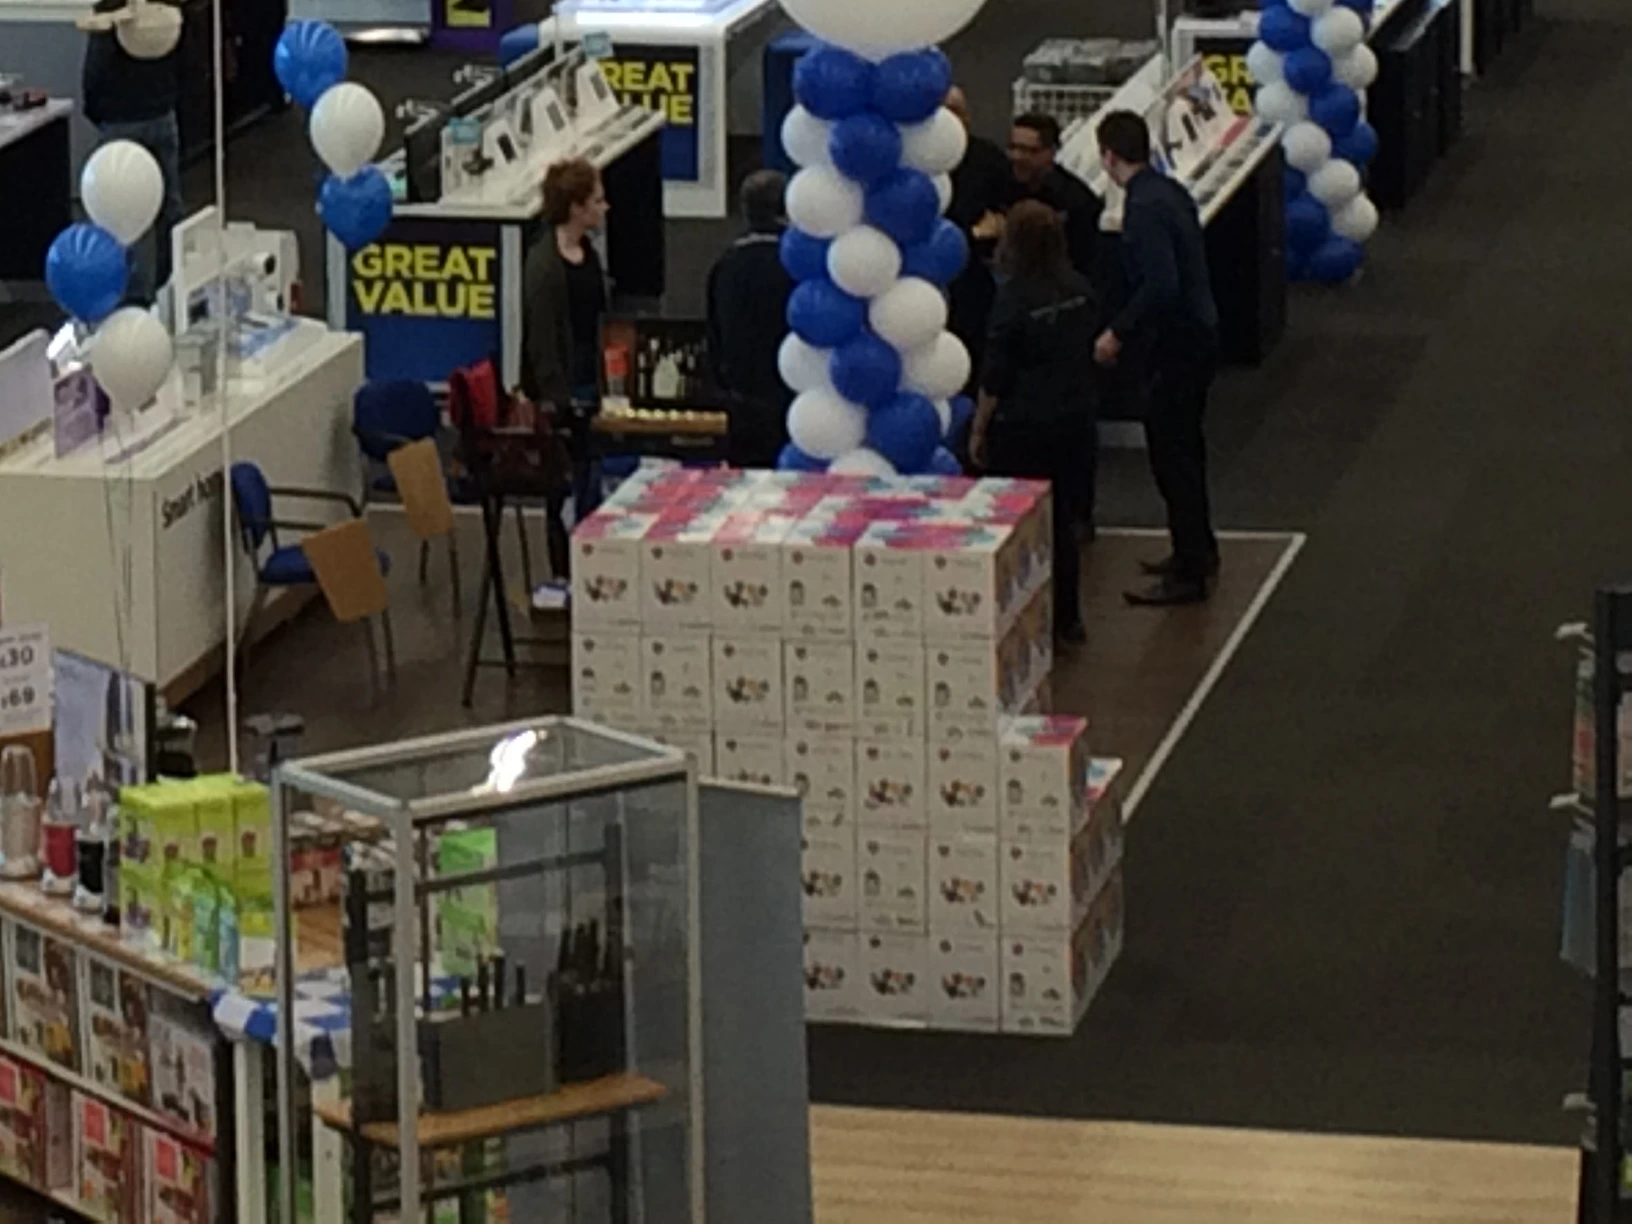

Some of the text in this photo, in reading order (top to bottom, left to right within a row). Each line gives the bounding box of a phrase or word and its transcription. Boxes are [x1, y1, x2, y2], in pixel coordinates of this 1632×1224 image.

[352, 243, 496, 280] GREAT
[352, 279, 496, 319] VALUE
[162, 482, 195, 529] Smart
